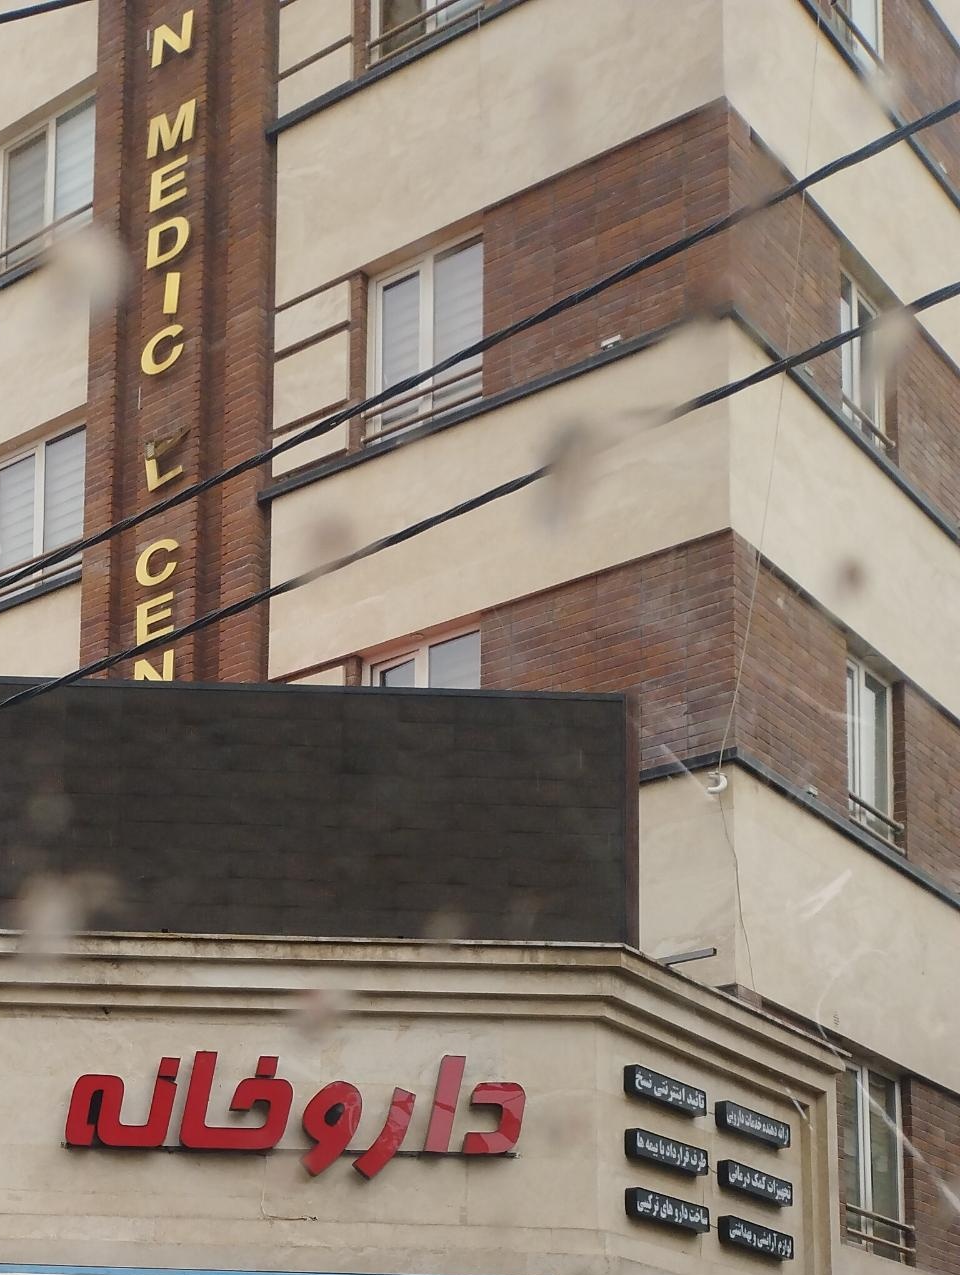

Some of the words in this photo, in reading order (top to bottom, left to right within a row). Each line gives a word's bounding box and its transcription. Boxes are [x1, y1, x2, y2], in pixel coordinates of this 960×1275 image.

[64, 1050, 527, 1179] داروخانه
[728, 1165, 751, 1188] درمانی
[751, 1173, 767, 1190] کمک
